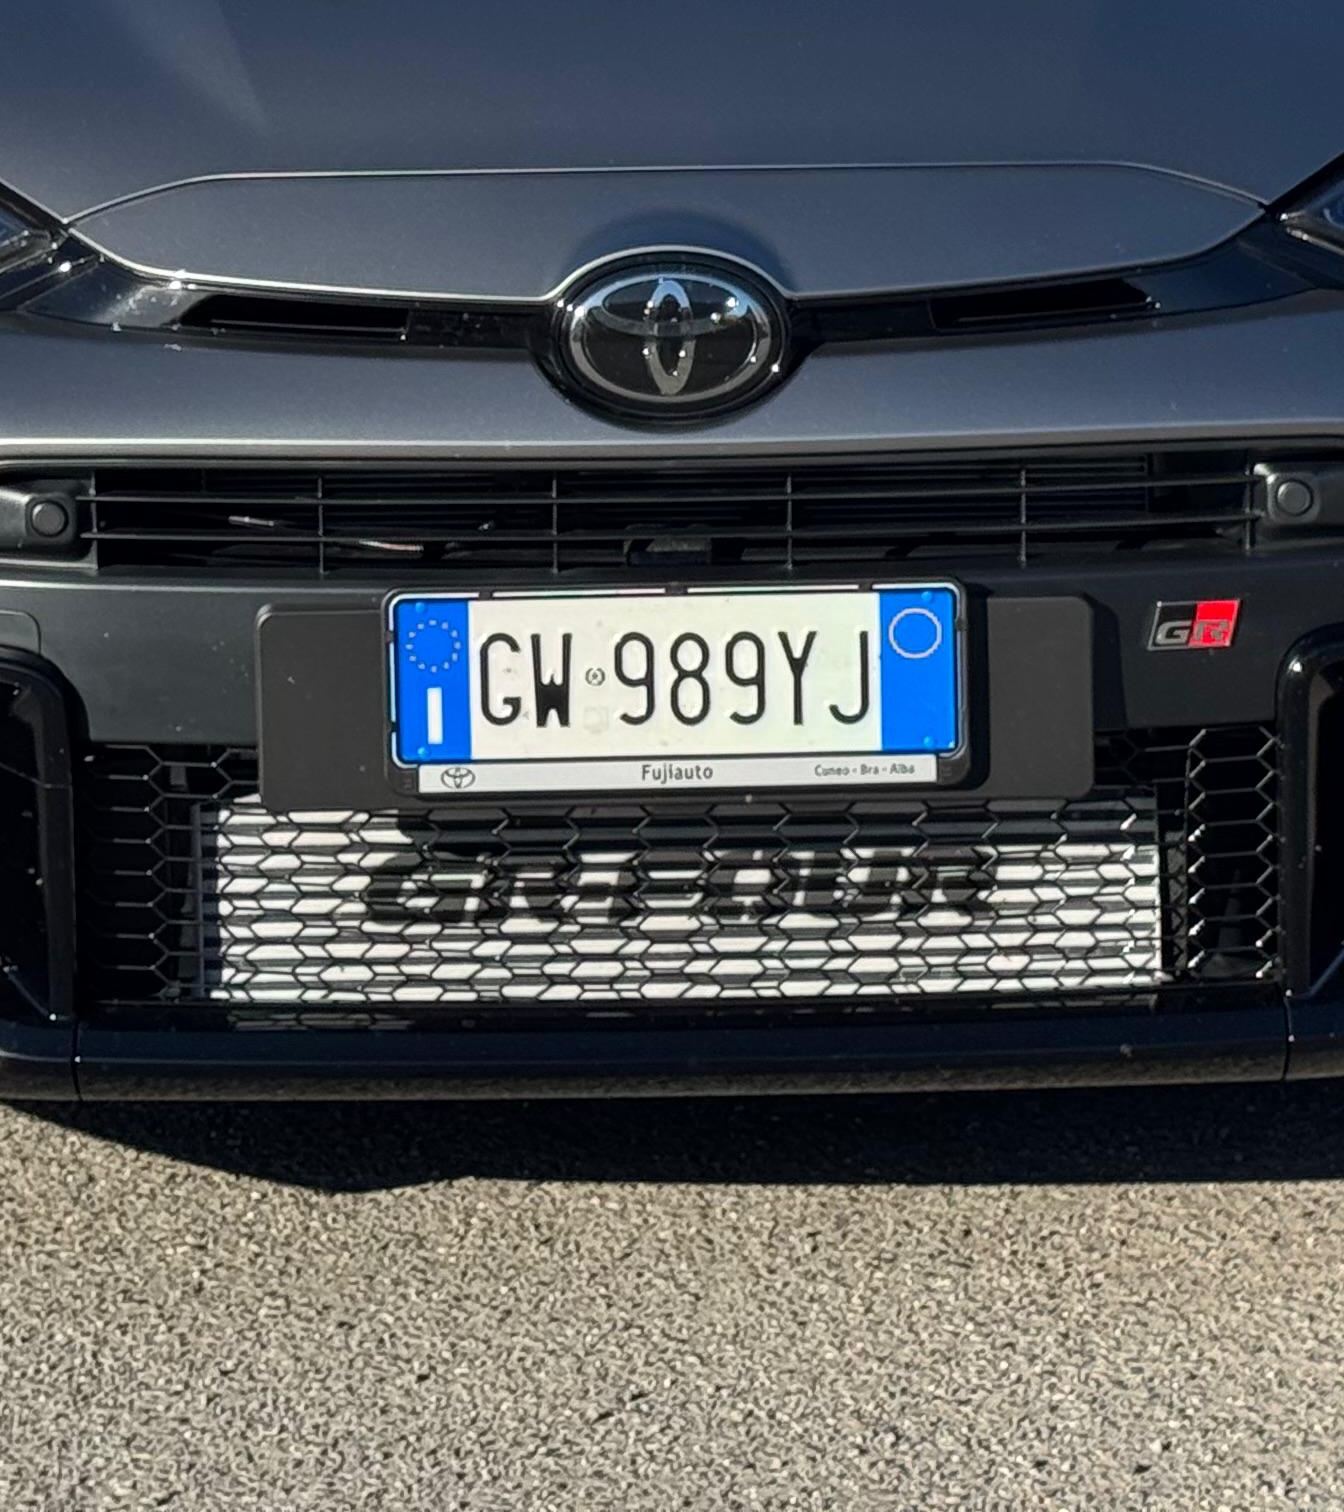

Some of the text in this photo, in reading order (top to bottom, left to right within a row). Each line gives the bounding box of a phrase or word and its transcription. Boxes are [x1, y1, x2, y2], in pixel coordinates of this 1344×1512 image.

[479, 630, 869, 729] GW 989YJ
[427, 687, 443, 745] I
[641, 762, 714, 785] Fujiauto
[814, 764, 850, 777] Cuneo
[860, 763, 880, 776] Bra
[889, 763, 916, 775] Alba
